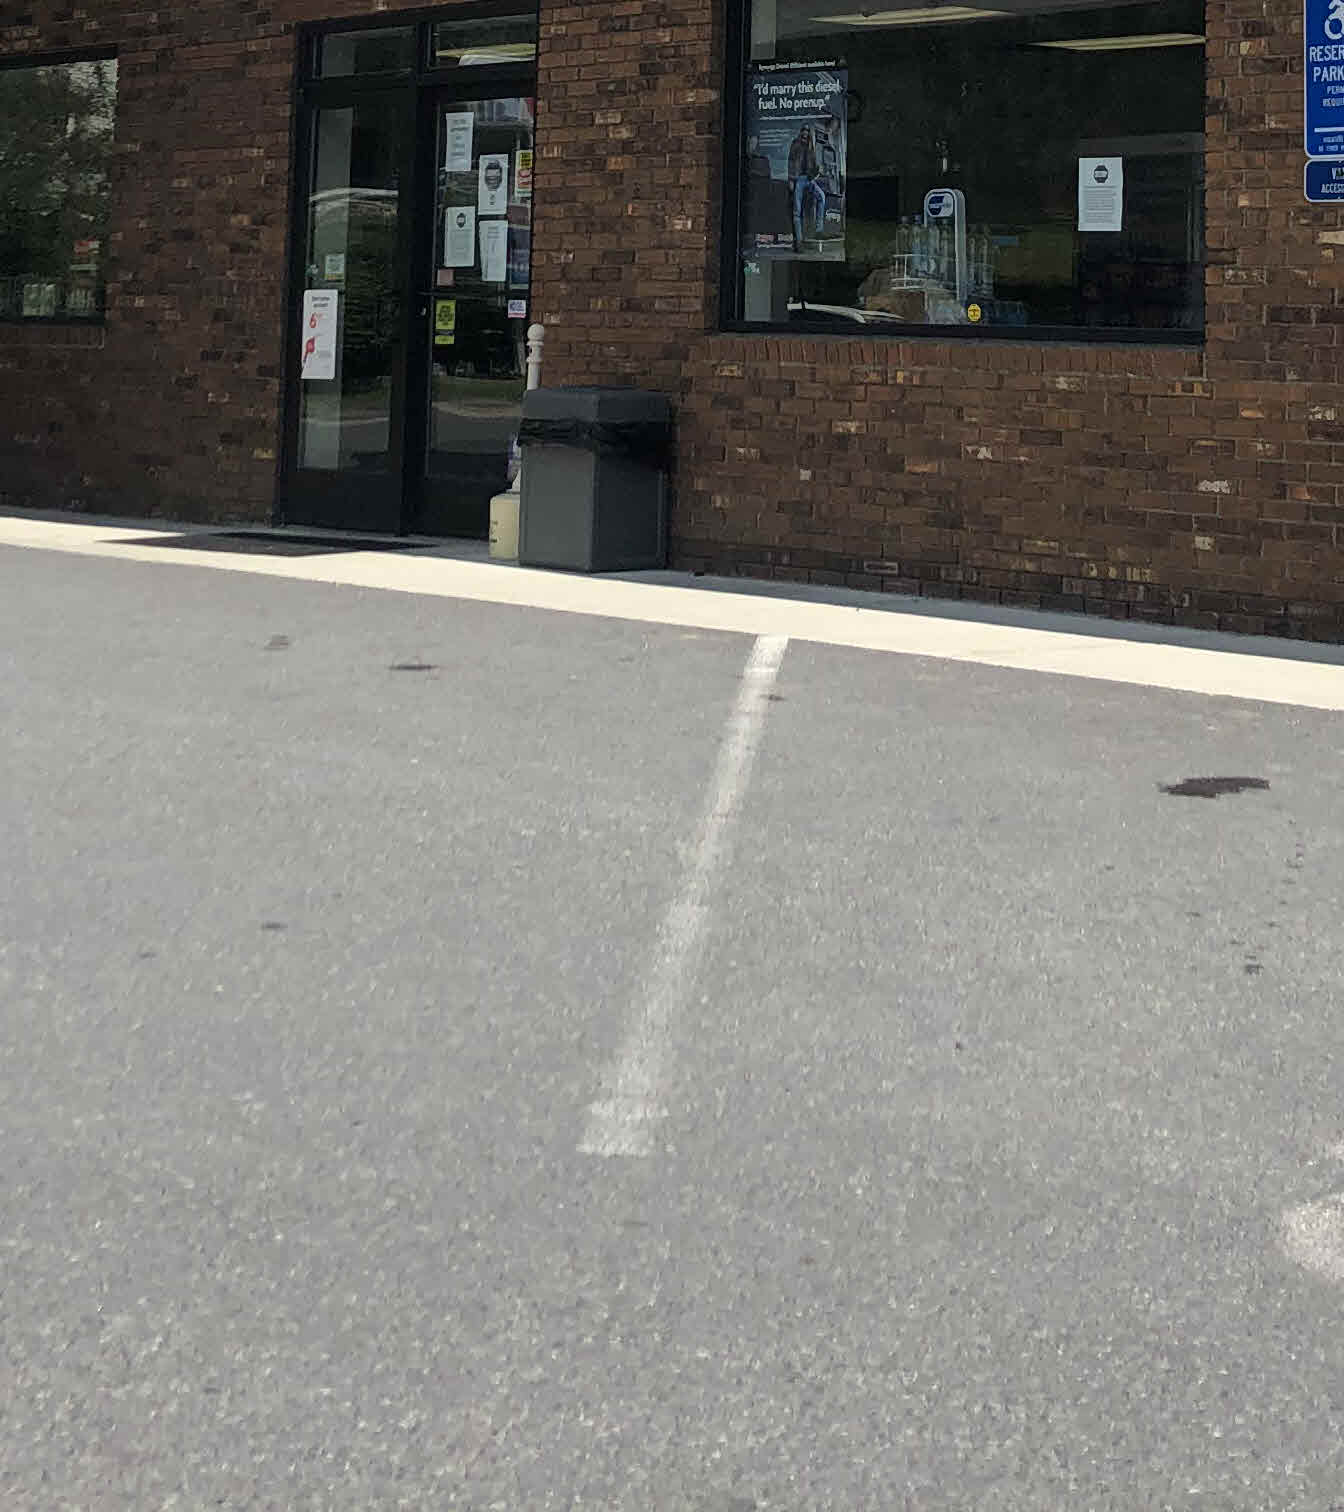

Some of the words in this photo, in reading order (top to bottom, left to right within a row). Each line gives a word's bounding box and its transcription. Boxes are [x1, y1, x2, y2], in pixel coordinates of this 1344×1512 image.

[770, 84, 798, 97] marry
[798, 80, 814, 94] this
[815, 79, 840, 93] diesel
[758, 97, 777, 110] fuel.
[780, 98, 794, 109] No
